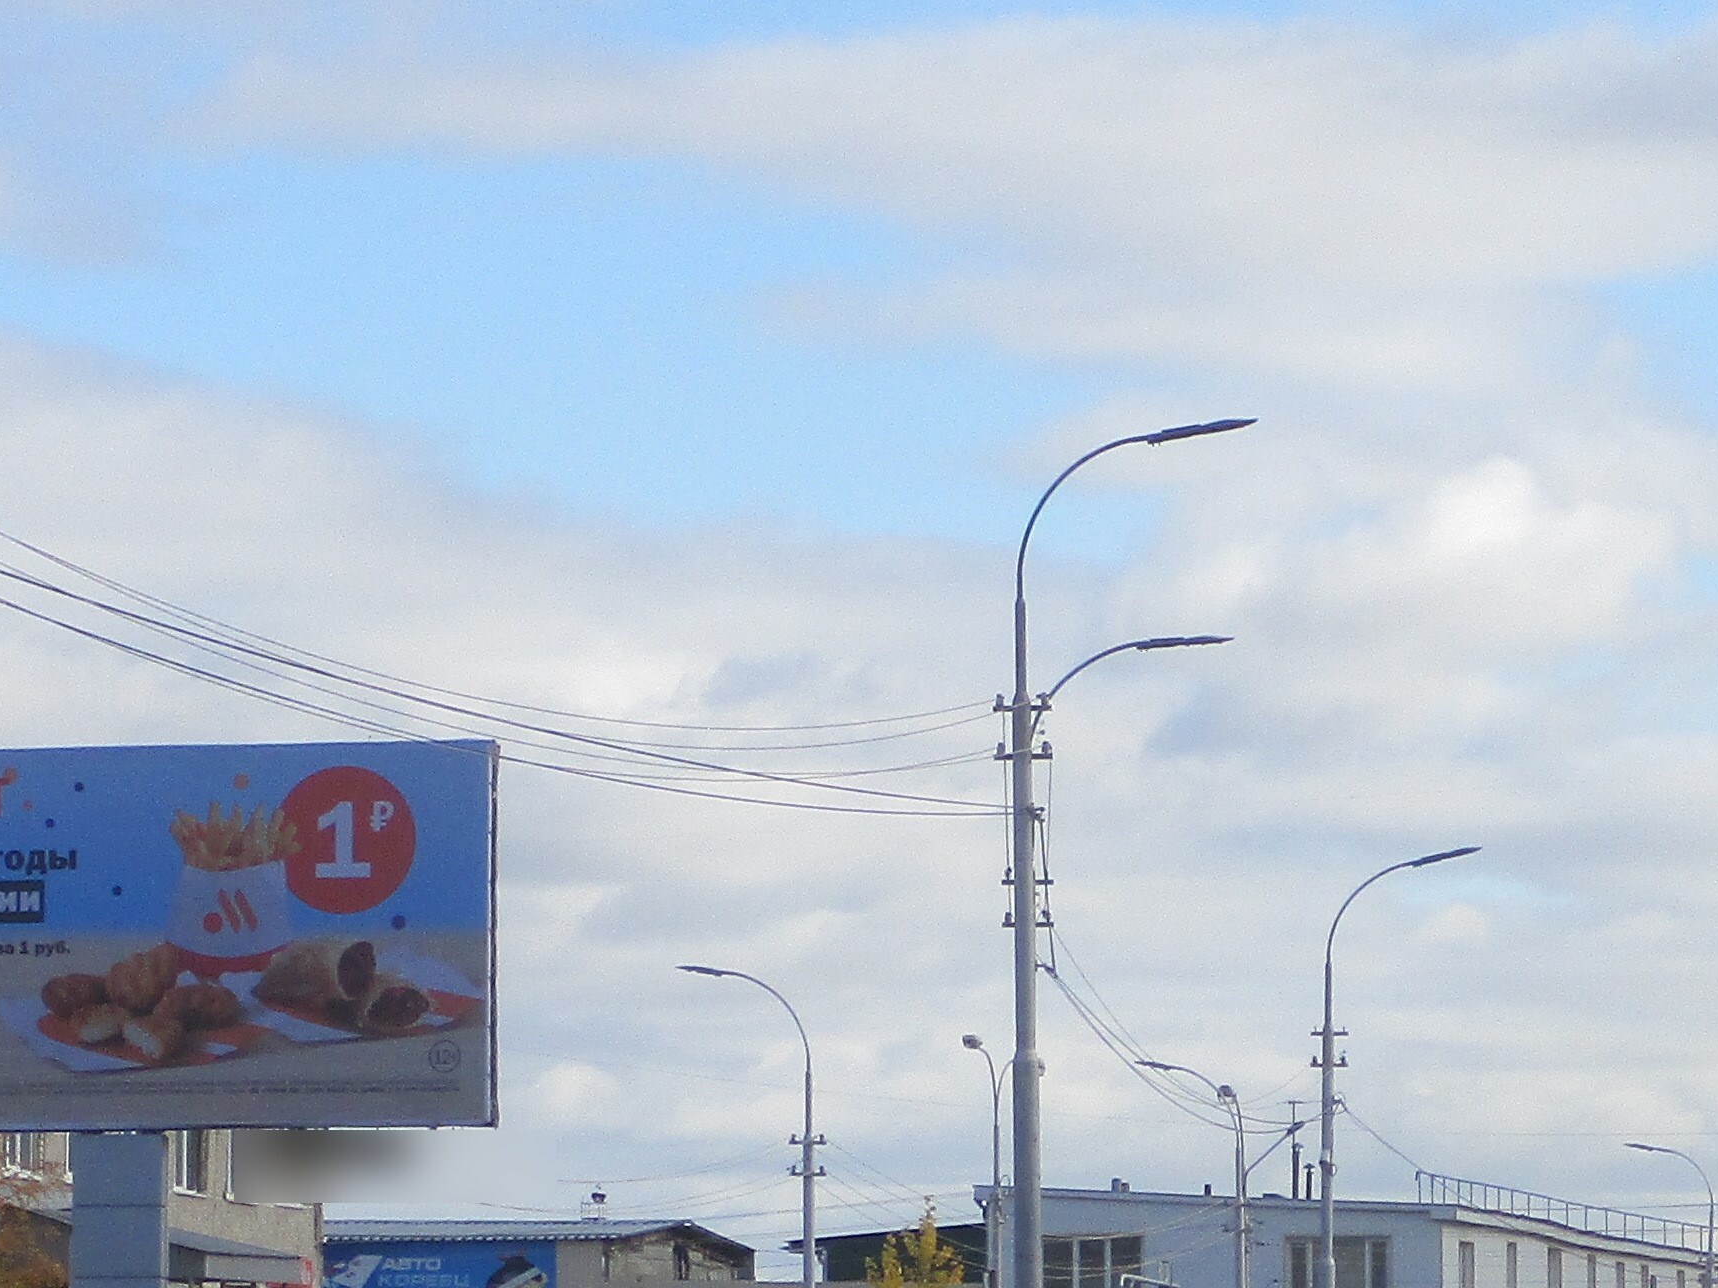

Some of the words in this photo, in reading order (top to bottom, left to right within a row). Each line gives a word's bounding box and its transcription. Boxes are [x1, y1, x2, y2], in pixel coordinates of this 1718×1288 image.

[18, 942, 30, 956] 1
[35, 941, 71, 958] руб.
[382, 1257, 442, 1271] АВТО
